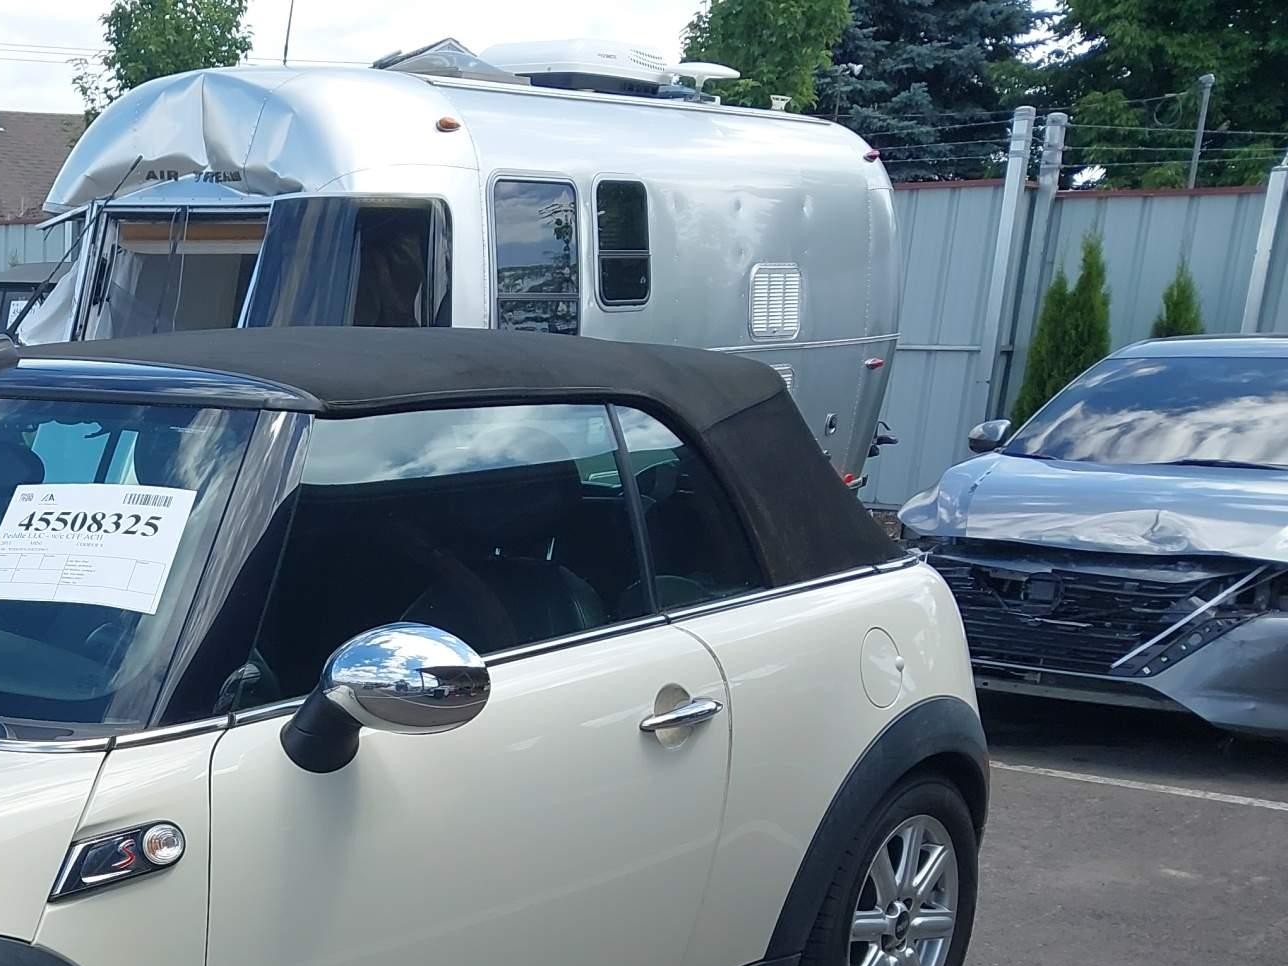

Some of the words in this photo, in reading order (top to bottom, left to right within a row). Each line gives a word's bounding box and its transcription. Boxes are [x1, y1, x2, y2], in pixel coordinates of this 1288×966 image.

[145, 169, 179, 182] AIR
[18, 511, 162, 537] 45508325
[111, 838, 136, 869] S
